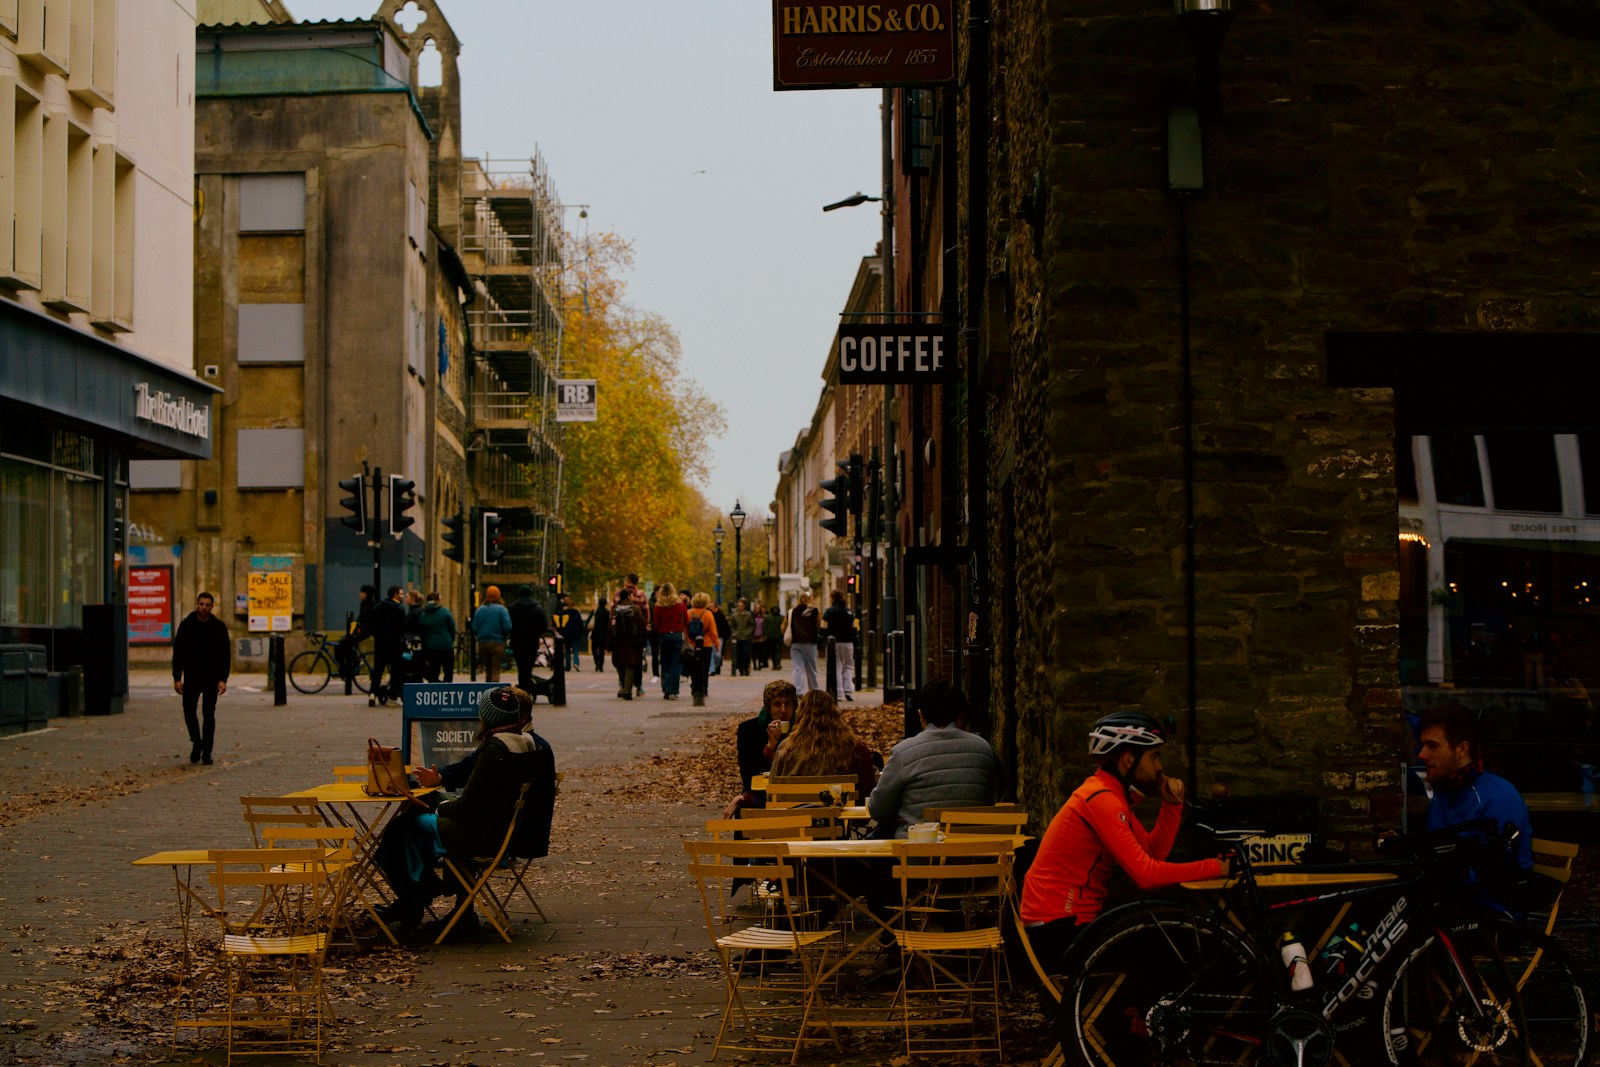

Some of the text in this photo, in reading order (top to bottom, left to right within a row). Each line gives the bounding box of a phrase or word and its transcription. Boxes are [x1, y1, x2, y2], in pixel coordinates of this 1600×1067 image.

[796, 47, 938, 72] Established 1855
[841, 336, 944, 372] COFFEE
[563, 385, 589, 403] RB
[134, 382, 208, 439] The Bristol Hotel
[252, 577, 289, 586] FOR SALE
[416, 691, 482, 705] SOCIETY CA
[436, 731, 474, 743] SOCIETY
[1361, 896, 1408, 957] ndale
[1322, 919, 1409, 1021] FOCUS
